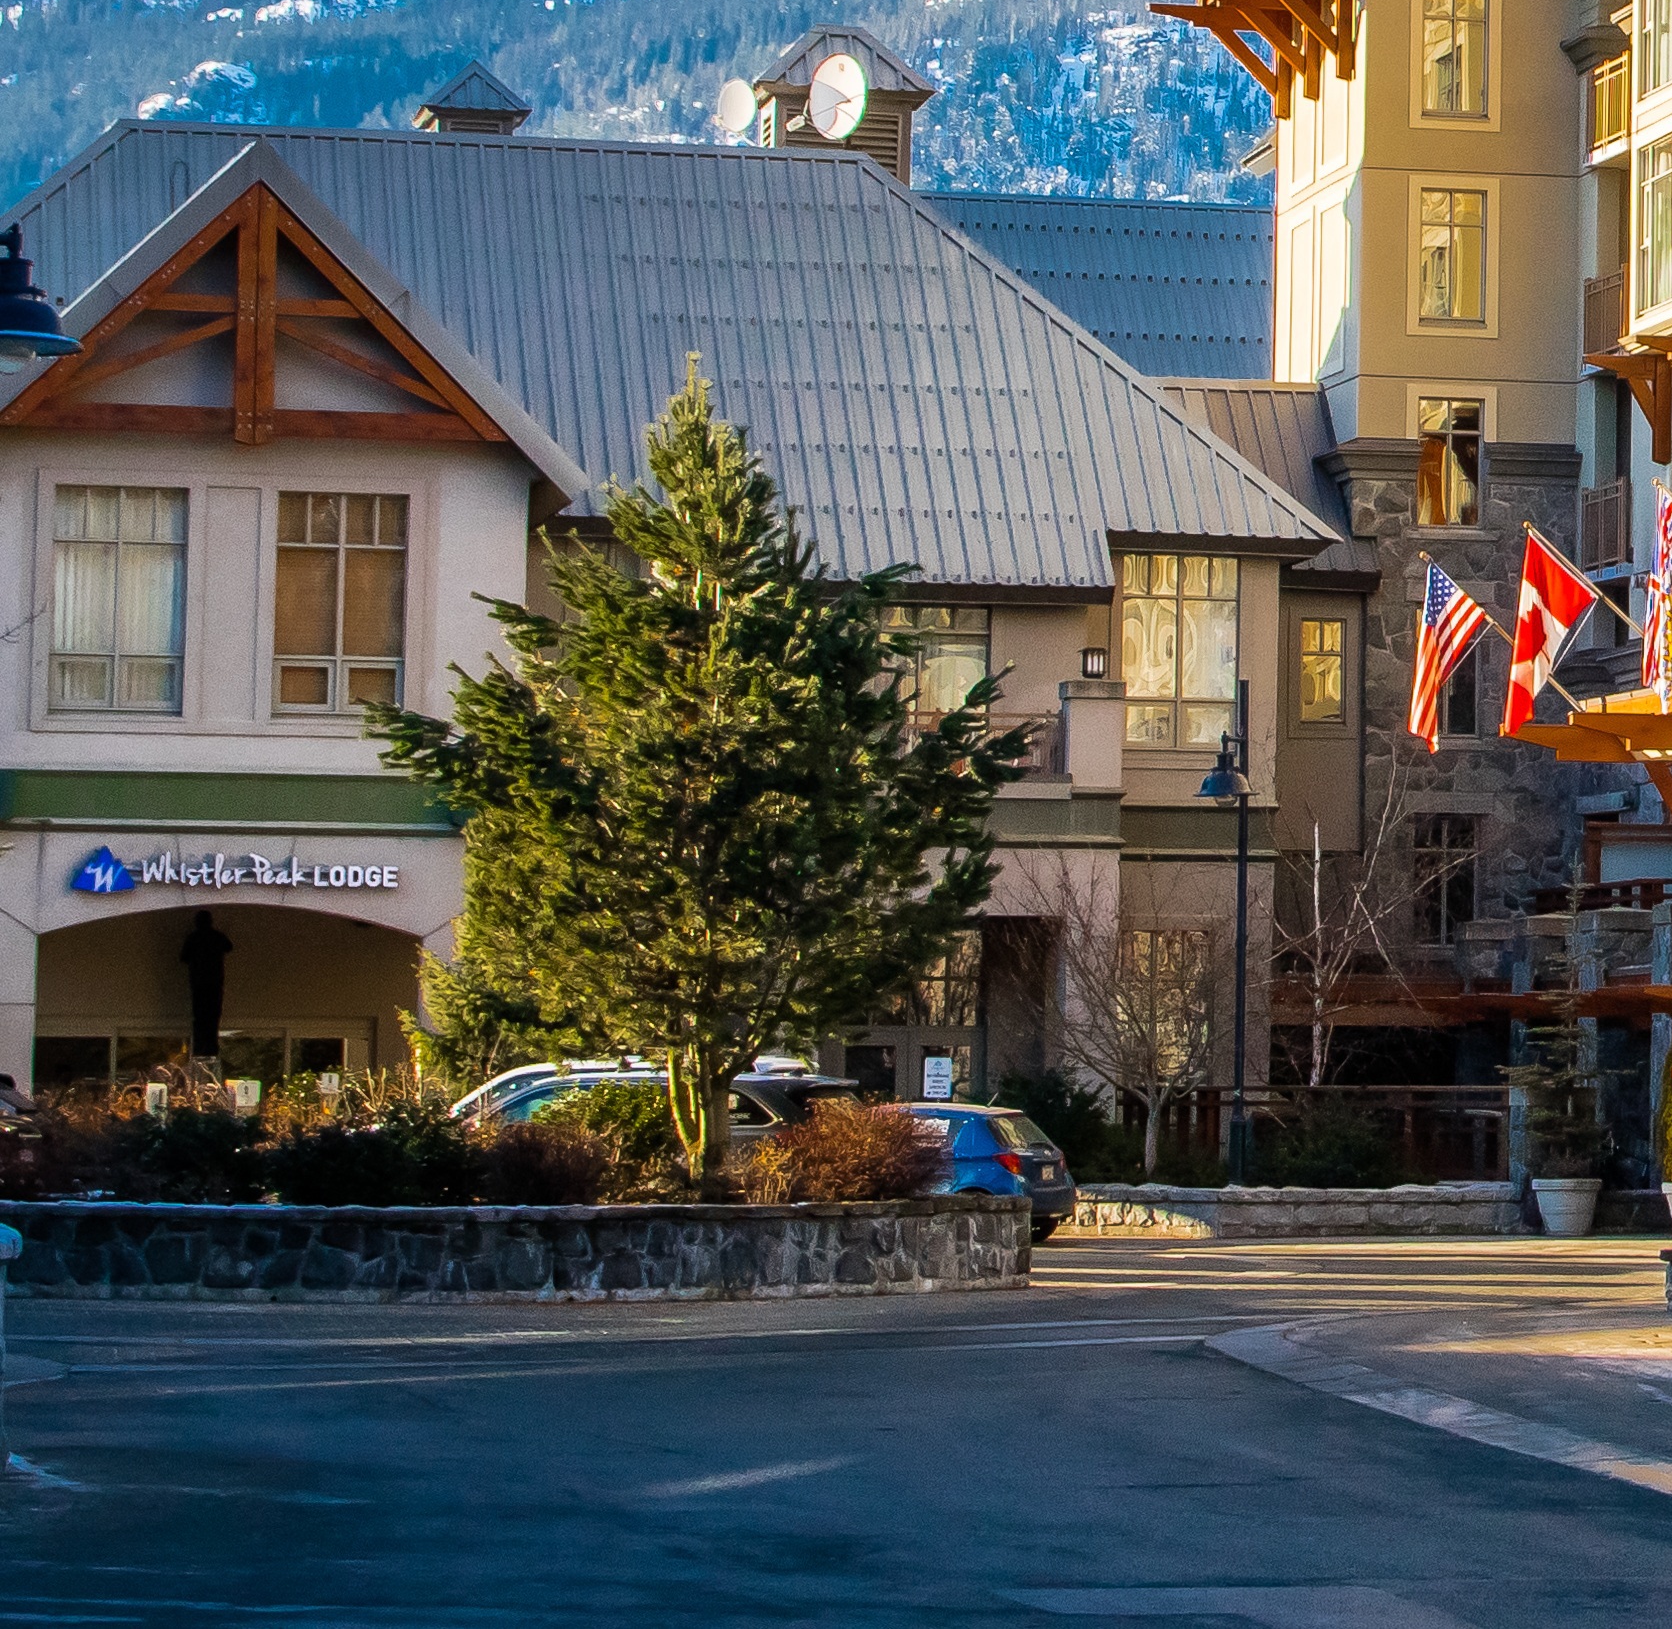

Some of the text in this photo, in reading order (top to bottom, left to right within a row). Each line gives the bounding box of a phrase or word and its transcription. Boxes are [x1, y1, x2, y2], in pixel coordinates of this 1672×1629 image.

[142, 850, 399, 889] Whistler Peak LODGE
